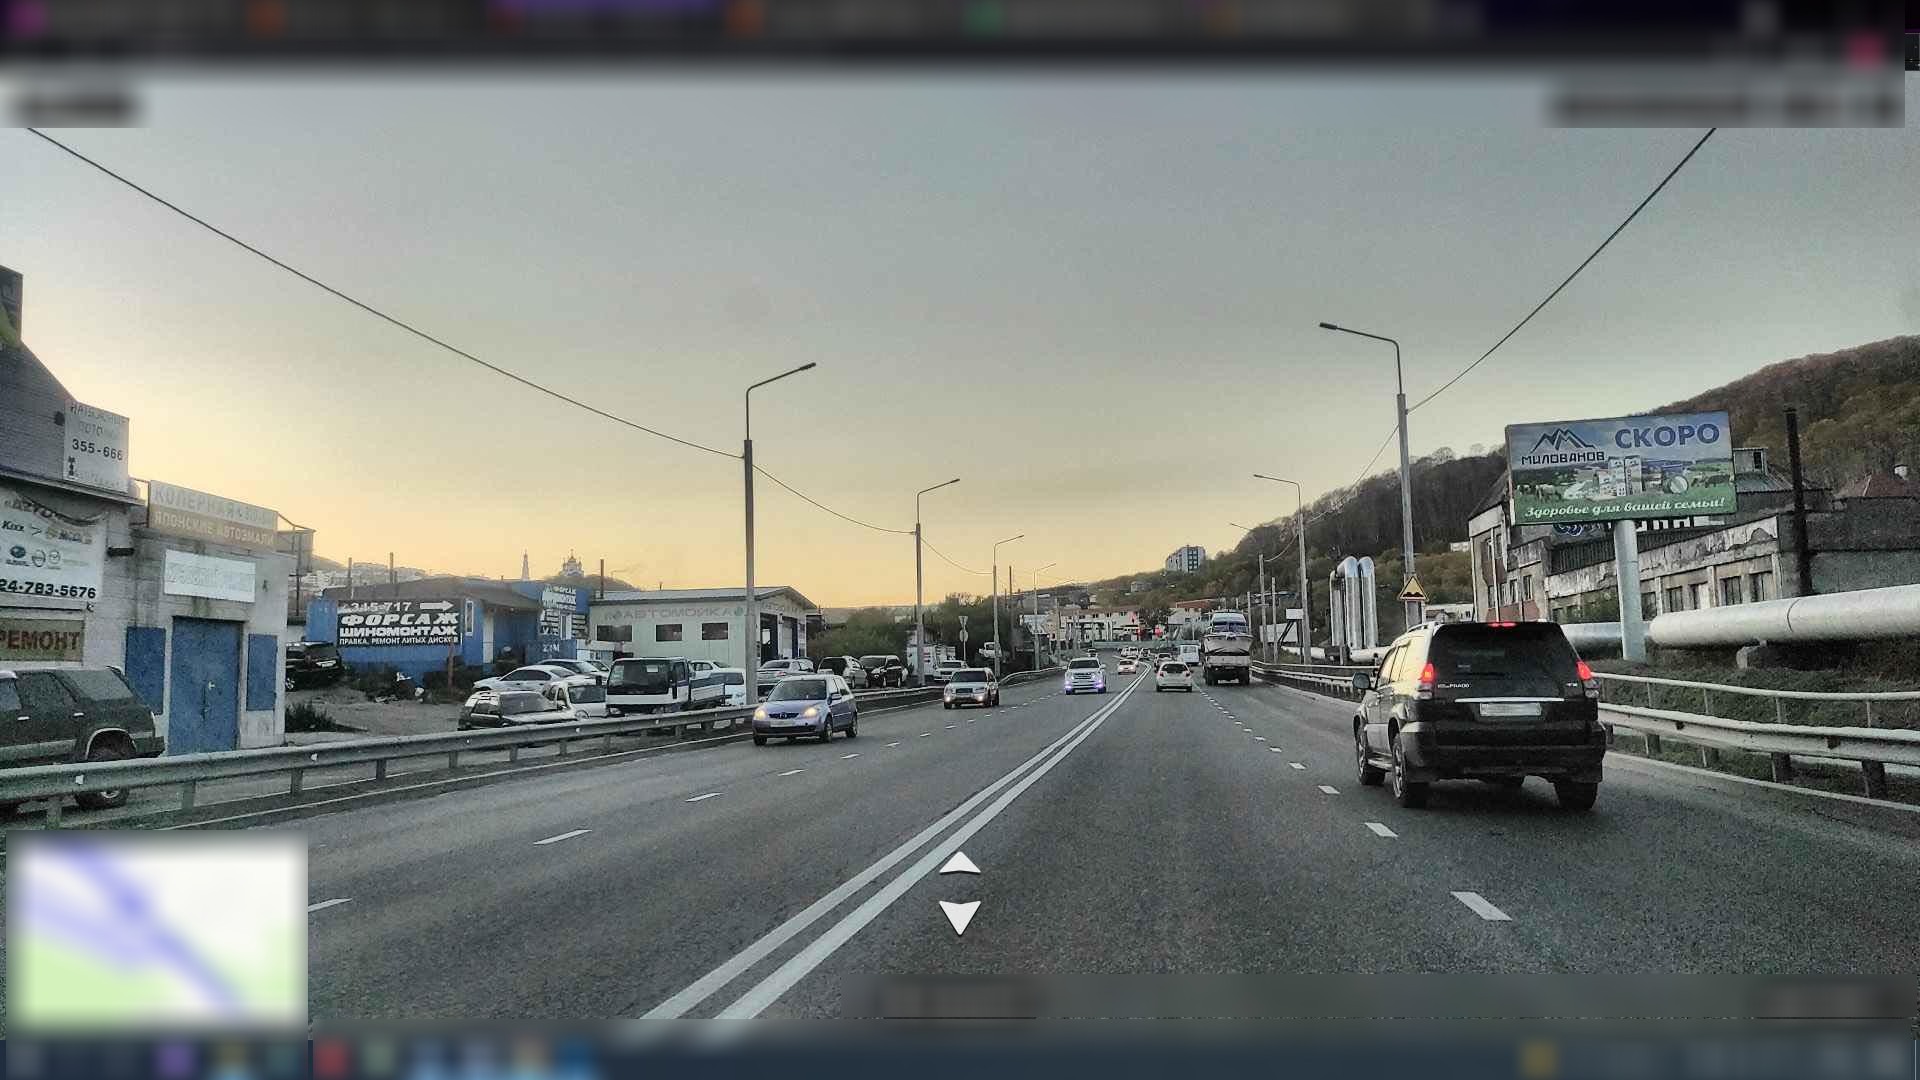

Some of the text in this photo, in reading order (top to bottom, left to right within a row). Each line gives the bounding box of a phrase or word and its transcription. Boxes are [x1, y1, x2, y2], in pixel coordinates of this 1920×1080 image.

[1614, 423, 1720, 449] СКОРО
[72, 438, 123, 461] 355-666
[1521, 451, 1605, 465] МИЛОВАНОВ
[1524, 496, 1725, 518] Здоровье для вашей семьи!
[341, 612, 460, 626] ФОРСАЖ
[624, 607, 732, 620] АВТОМОЙКА
[339, 625, 458, 637] ШИНОМОНТАЖ
[371, 637, 400, 645] РЕМОНТ
